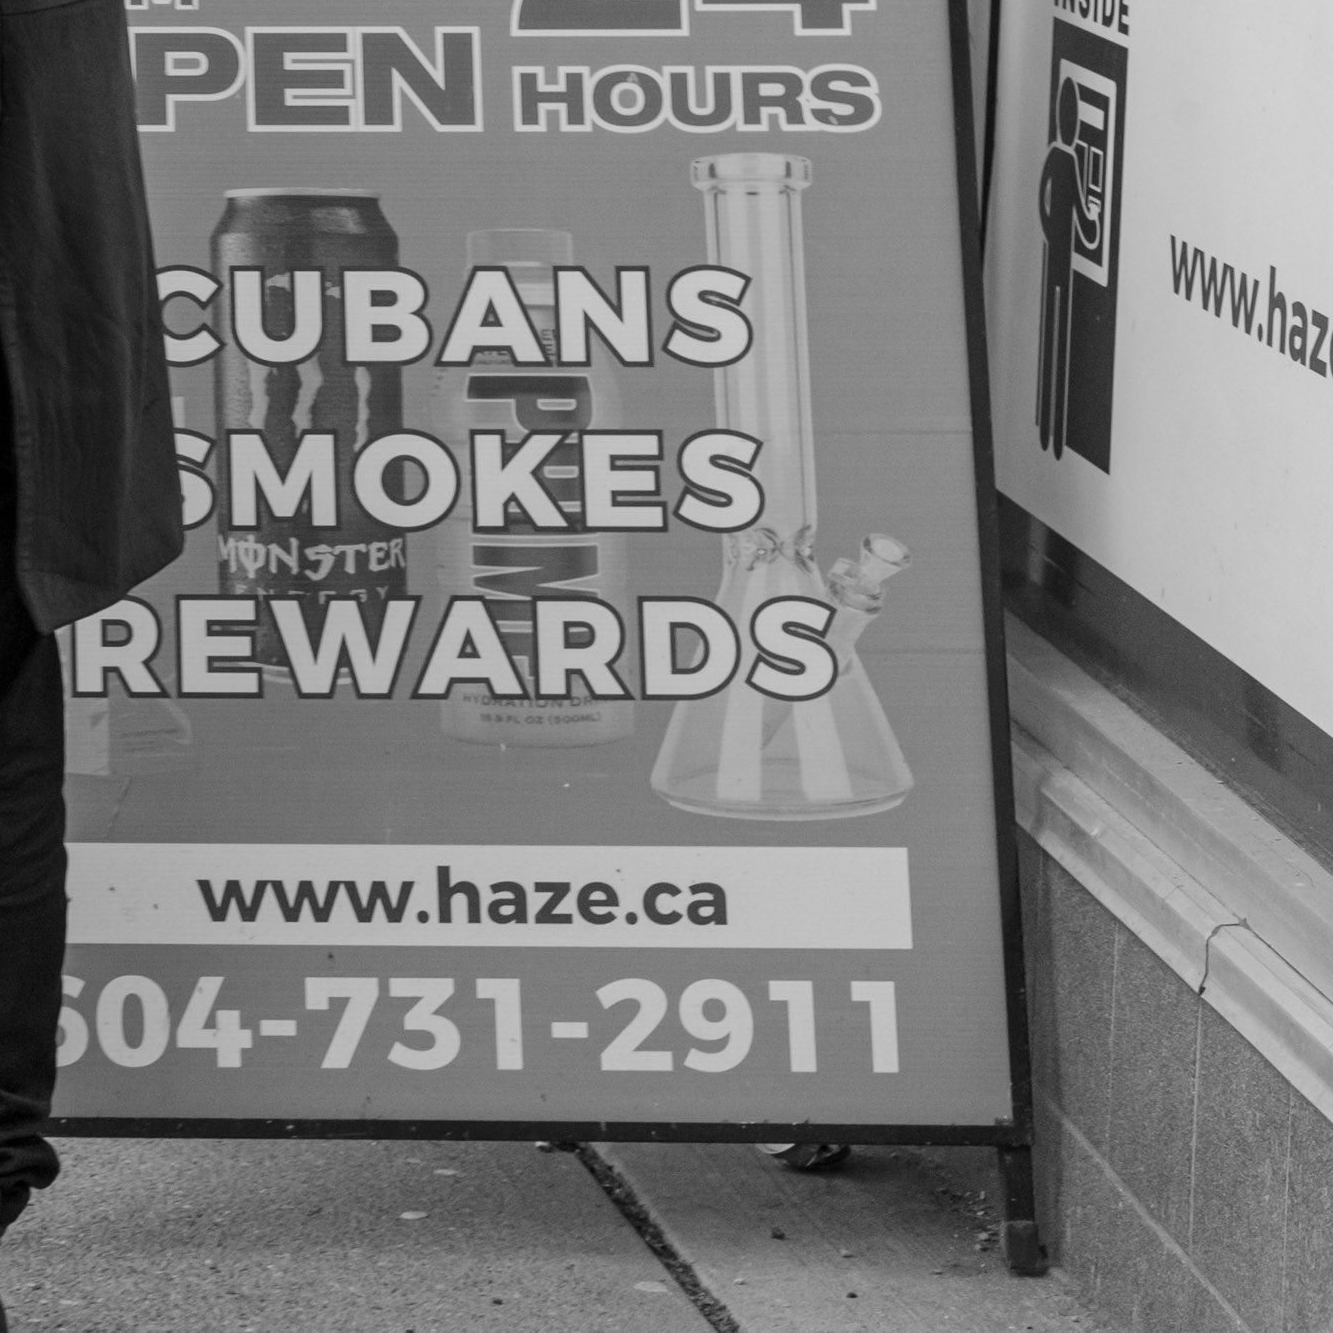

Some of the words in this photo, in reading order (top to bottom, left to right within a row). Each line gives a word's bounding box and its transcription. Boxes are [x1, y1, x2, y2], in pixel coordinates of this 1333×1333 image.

[127, 26, 482, 133] PEN
[513, 63, 882, 134] HOURS
[155, 264, 754, 368] CUBANS
[1170, 234, 1333, 379] www.haz
[218, 534, 406, 581] MONSTER
[71, 594, 839, 701] REWARDS
[195, 865, 729, 927] www.haze.ca
[56, 975, 900, 1074] 604-731-2911
